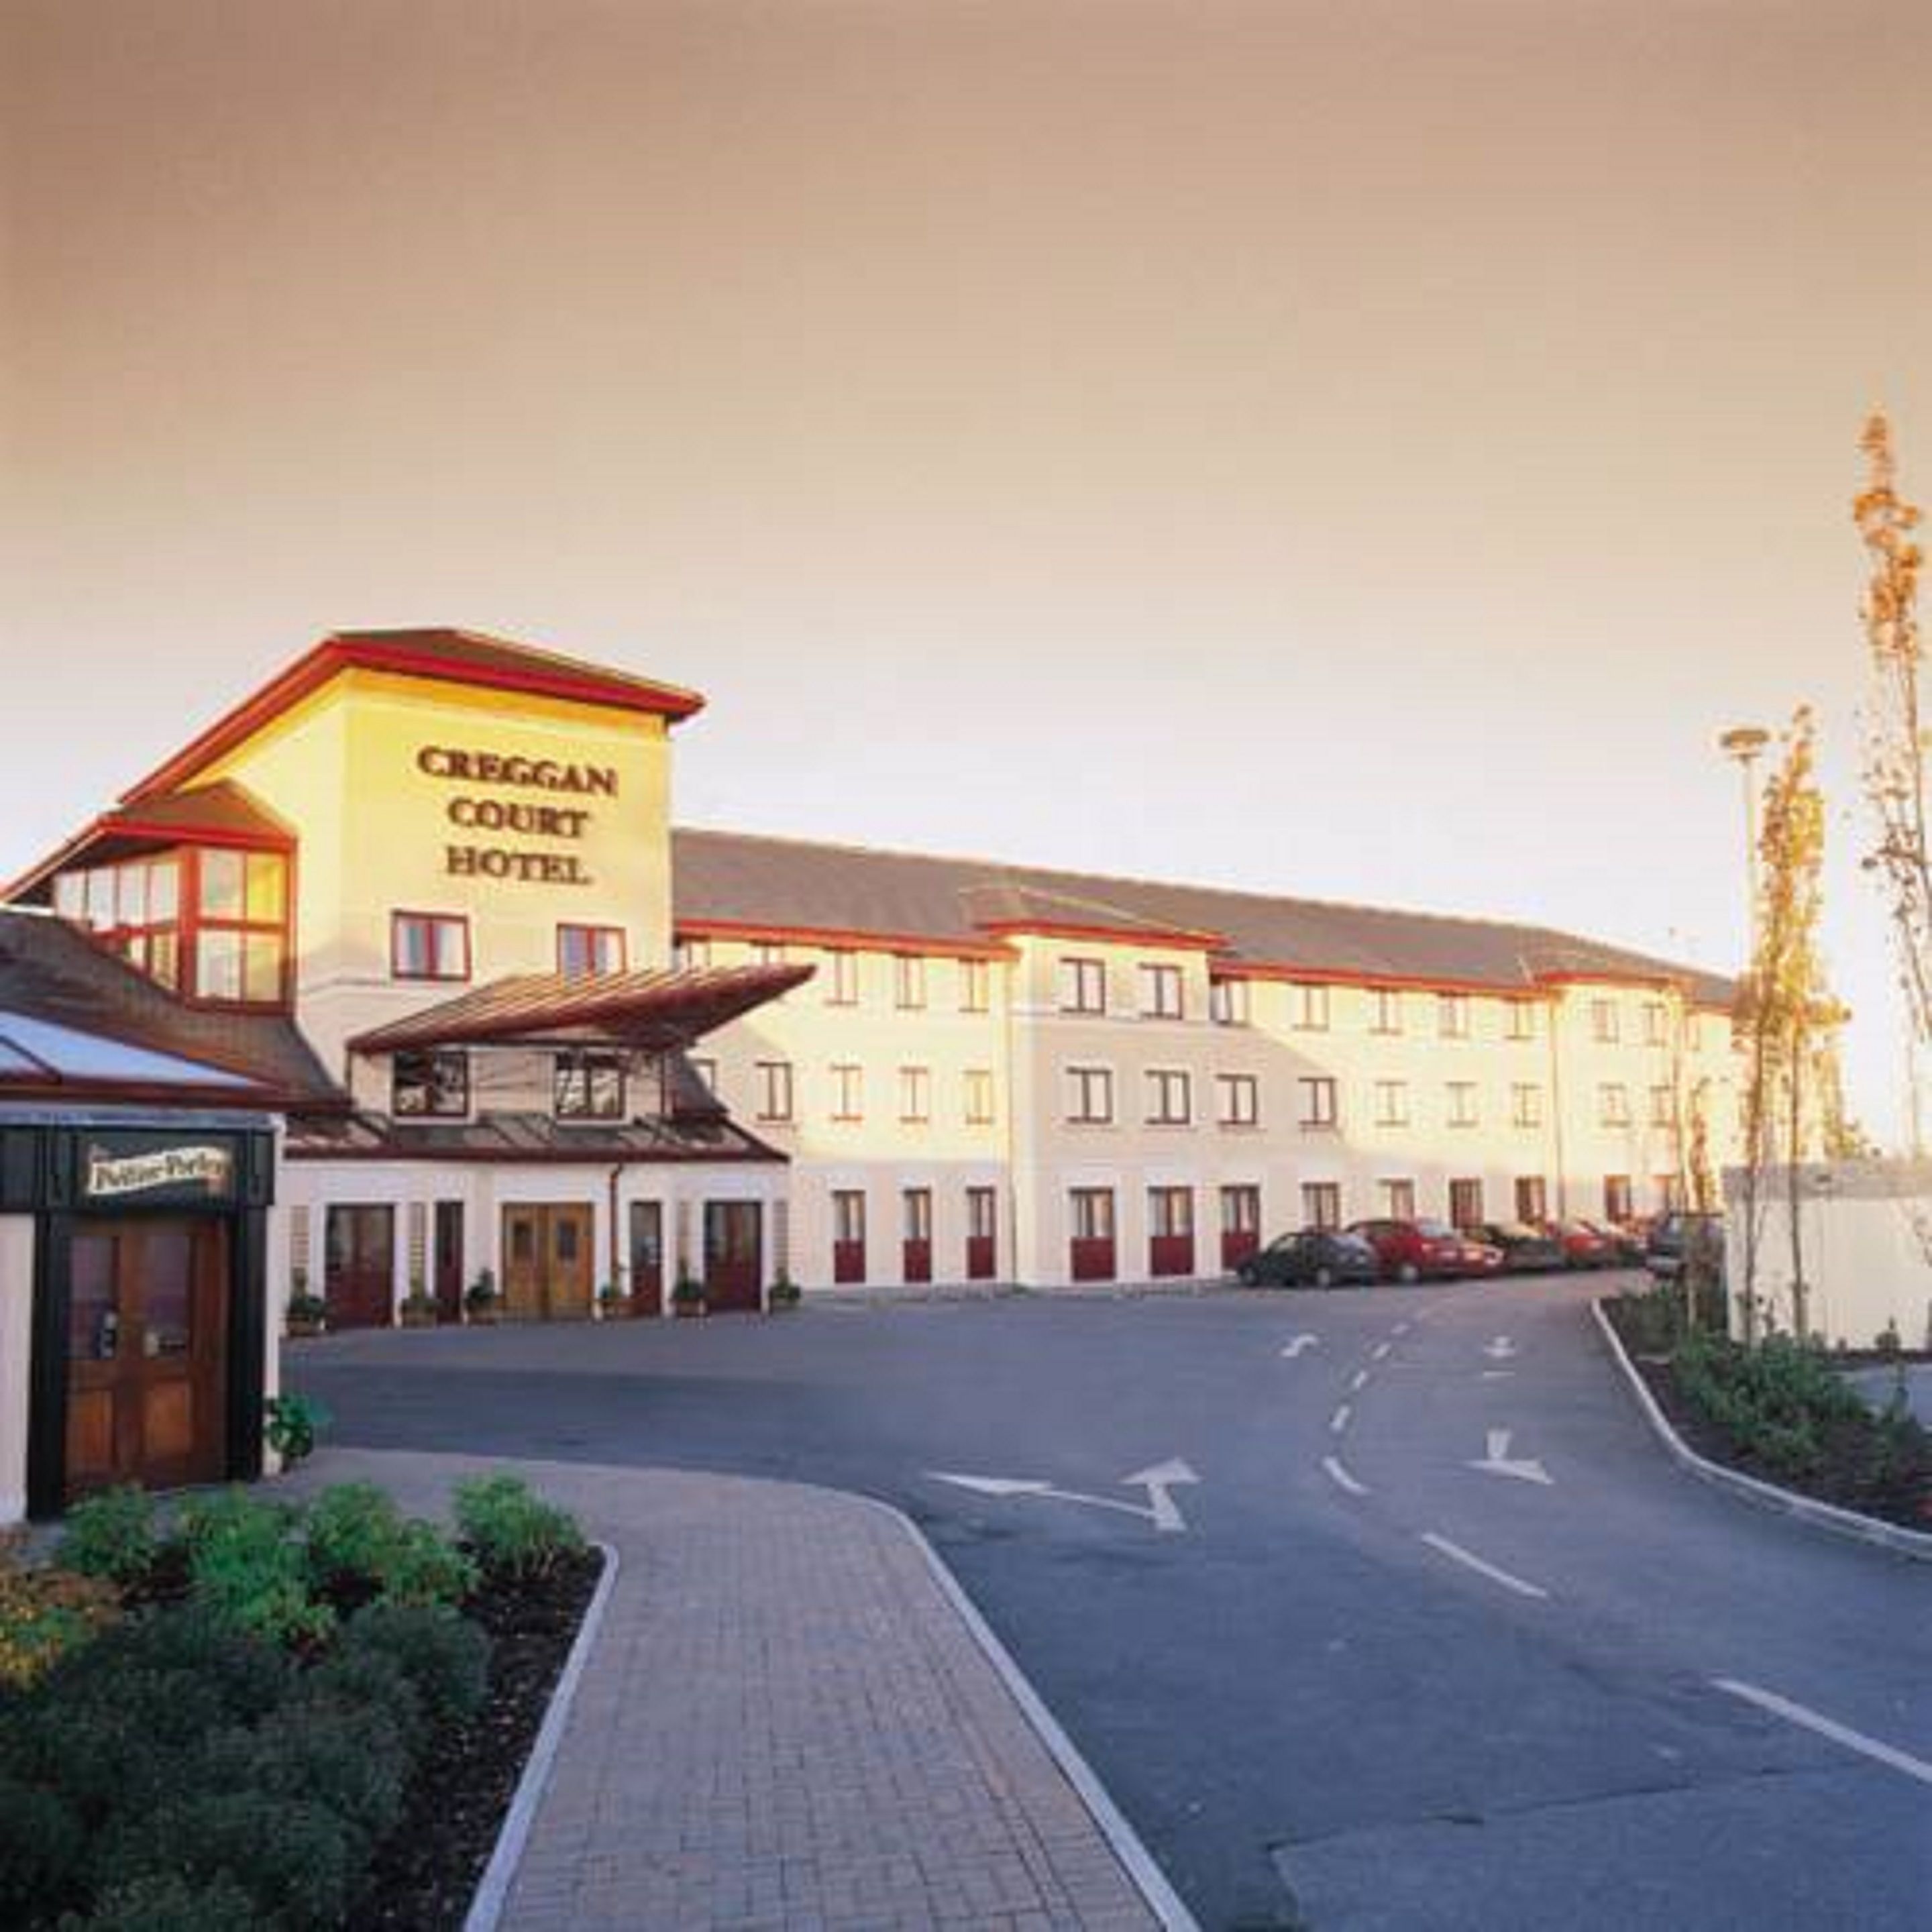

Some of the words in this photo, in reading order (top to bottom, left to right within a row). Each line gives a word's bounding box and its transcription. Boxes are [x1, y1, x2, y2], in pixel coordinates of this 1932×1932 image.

[417, 745, 617, 796] CREGGAN
[447, 798, 590, 838] COURT
[446, 845, 593, 885] HOTEL
